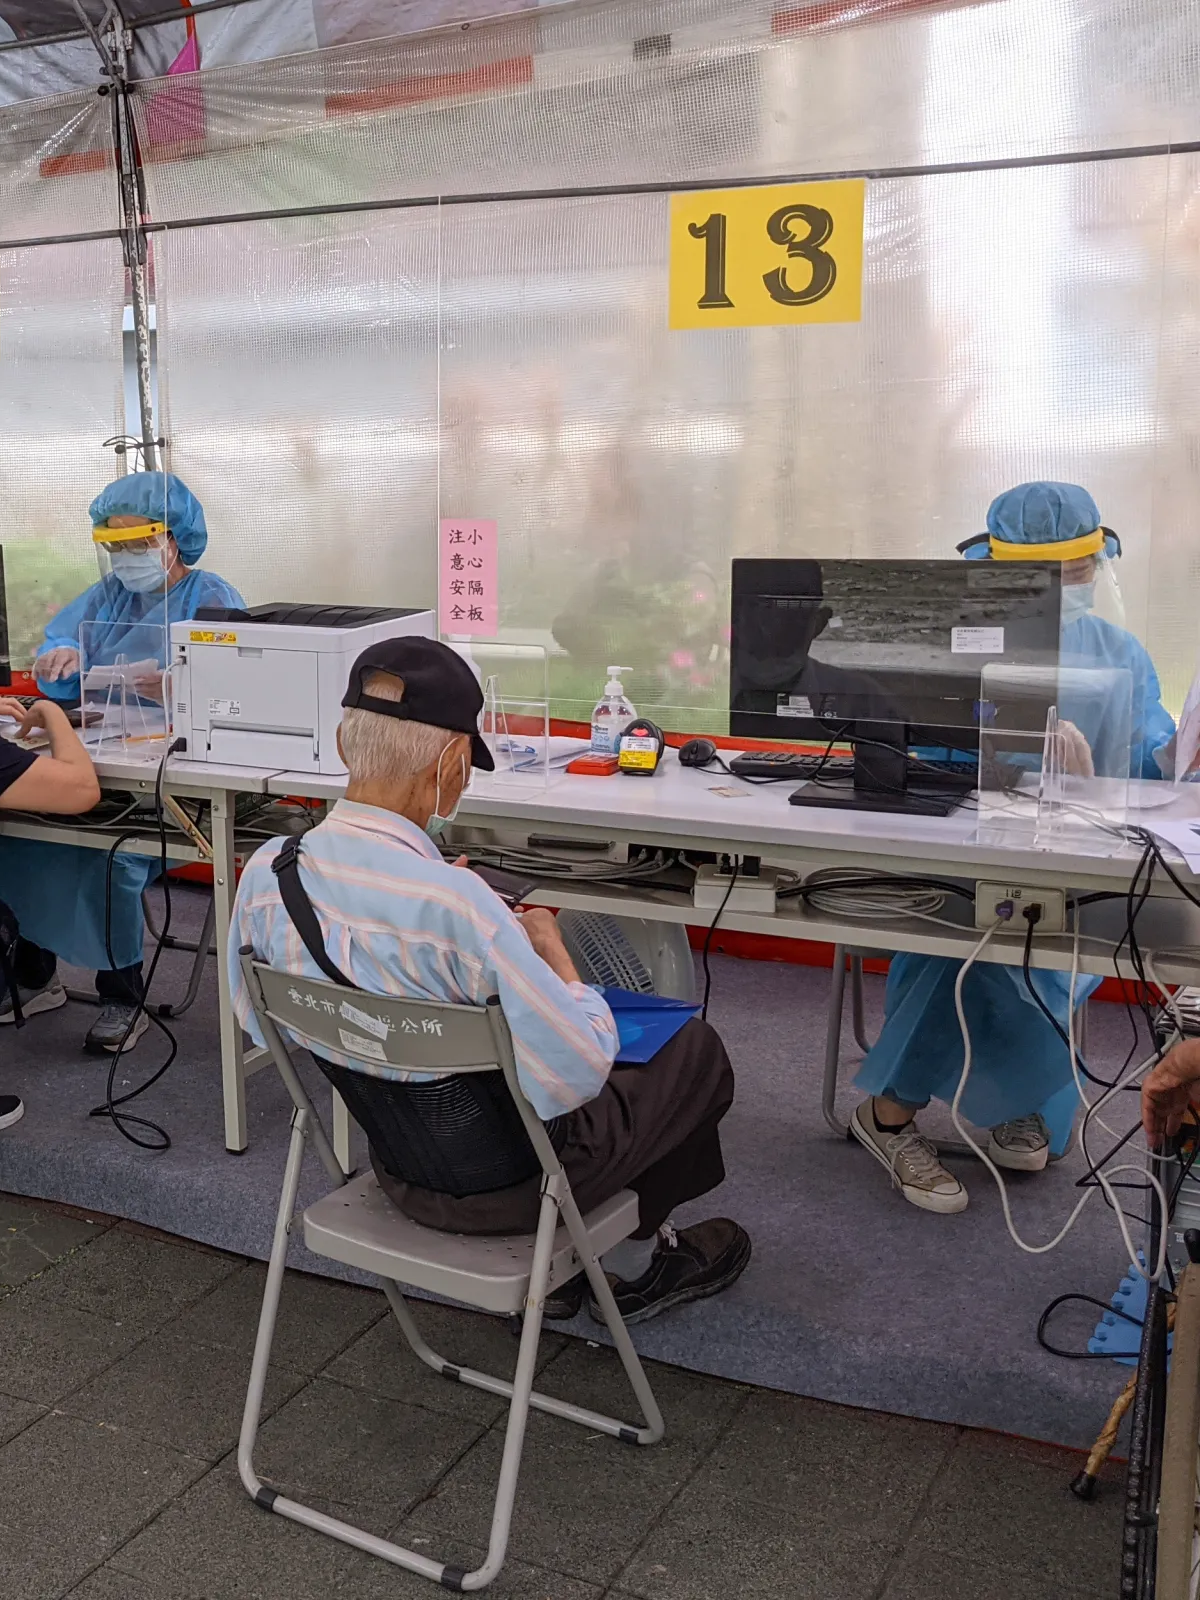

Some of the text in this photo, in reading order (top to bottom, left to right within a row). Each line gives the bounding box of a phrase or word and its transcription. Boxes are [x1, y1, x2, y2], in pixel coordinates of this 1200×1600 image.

[687, 203, 837, 310] 13
[448, 528, 467, 621] 注意安全
[467, 528, 485, 622] 小心隔板
[287, 985, 444, 1037] 臺北市區公所
